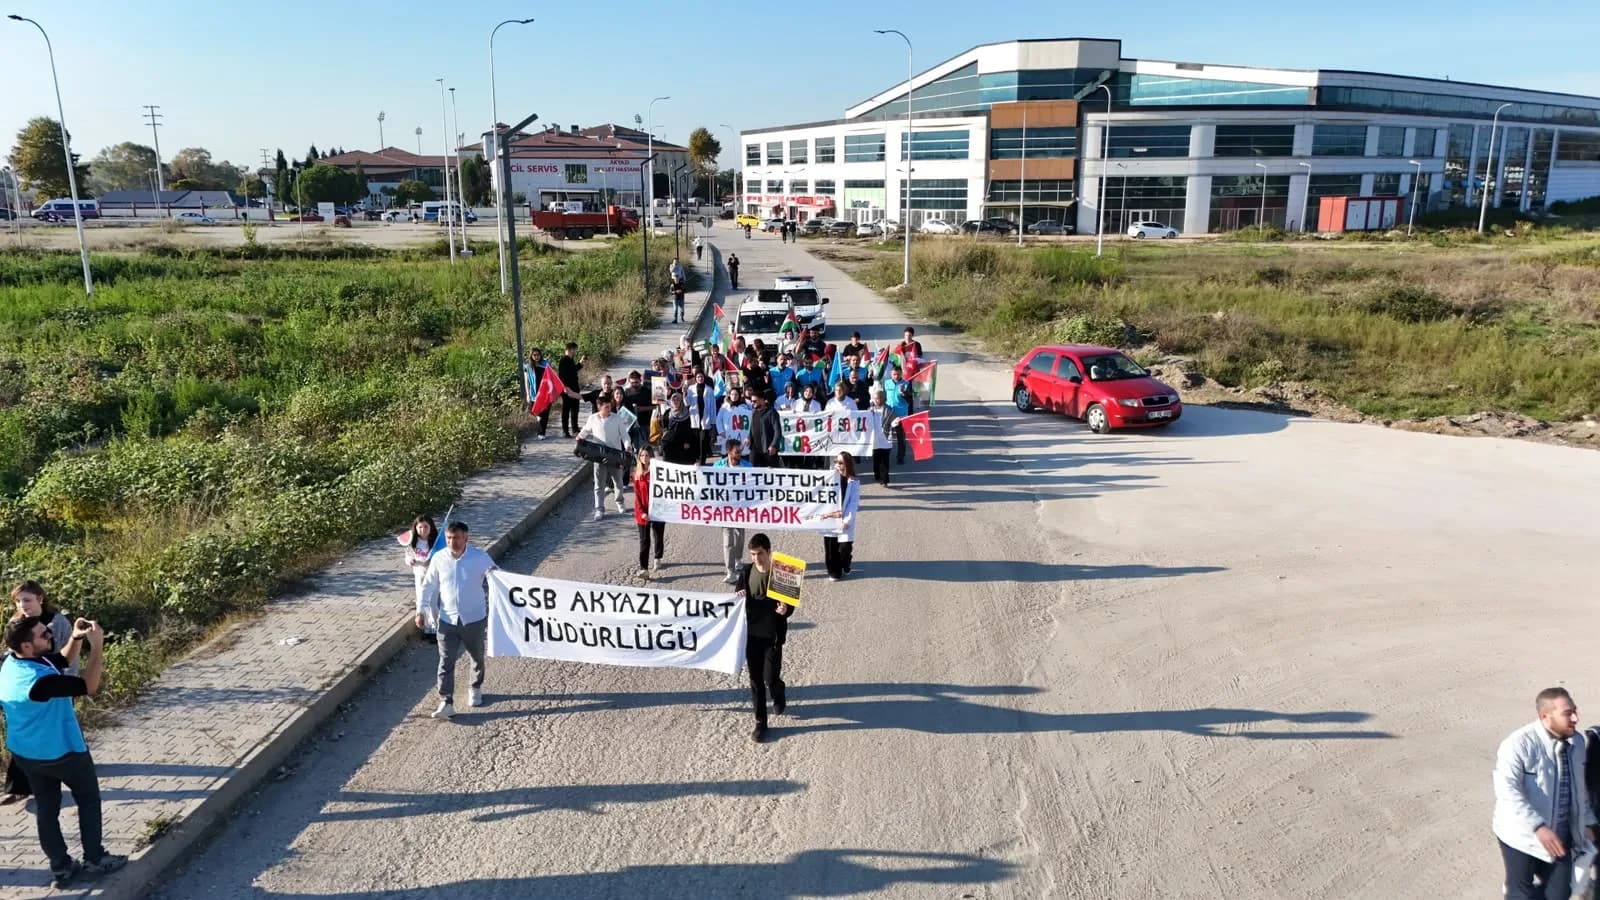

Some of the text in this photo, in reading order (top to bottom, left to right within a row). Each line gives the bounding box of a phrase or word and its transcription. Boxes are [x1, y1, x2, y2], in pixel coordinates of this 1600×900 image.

[511, 162, 559, 173] CİL SERVİS
[703, 471, 746, 486] TUT!
[751, 473, 839, 487] TUTTUM...
[653, 484, 695, 500] DAHA
[700, 487, 730, 502] SIKI
[680, 503, 802, 524] BAŞARAMADIK
[508, 586, 735, 619] GSB AKYAZI YURT
[524, 617, 698, 651] MÜDÜRLÜĞÜ
